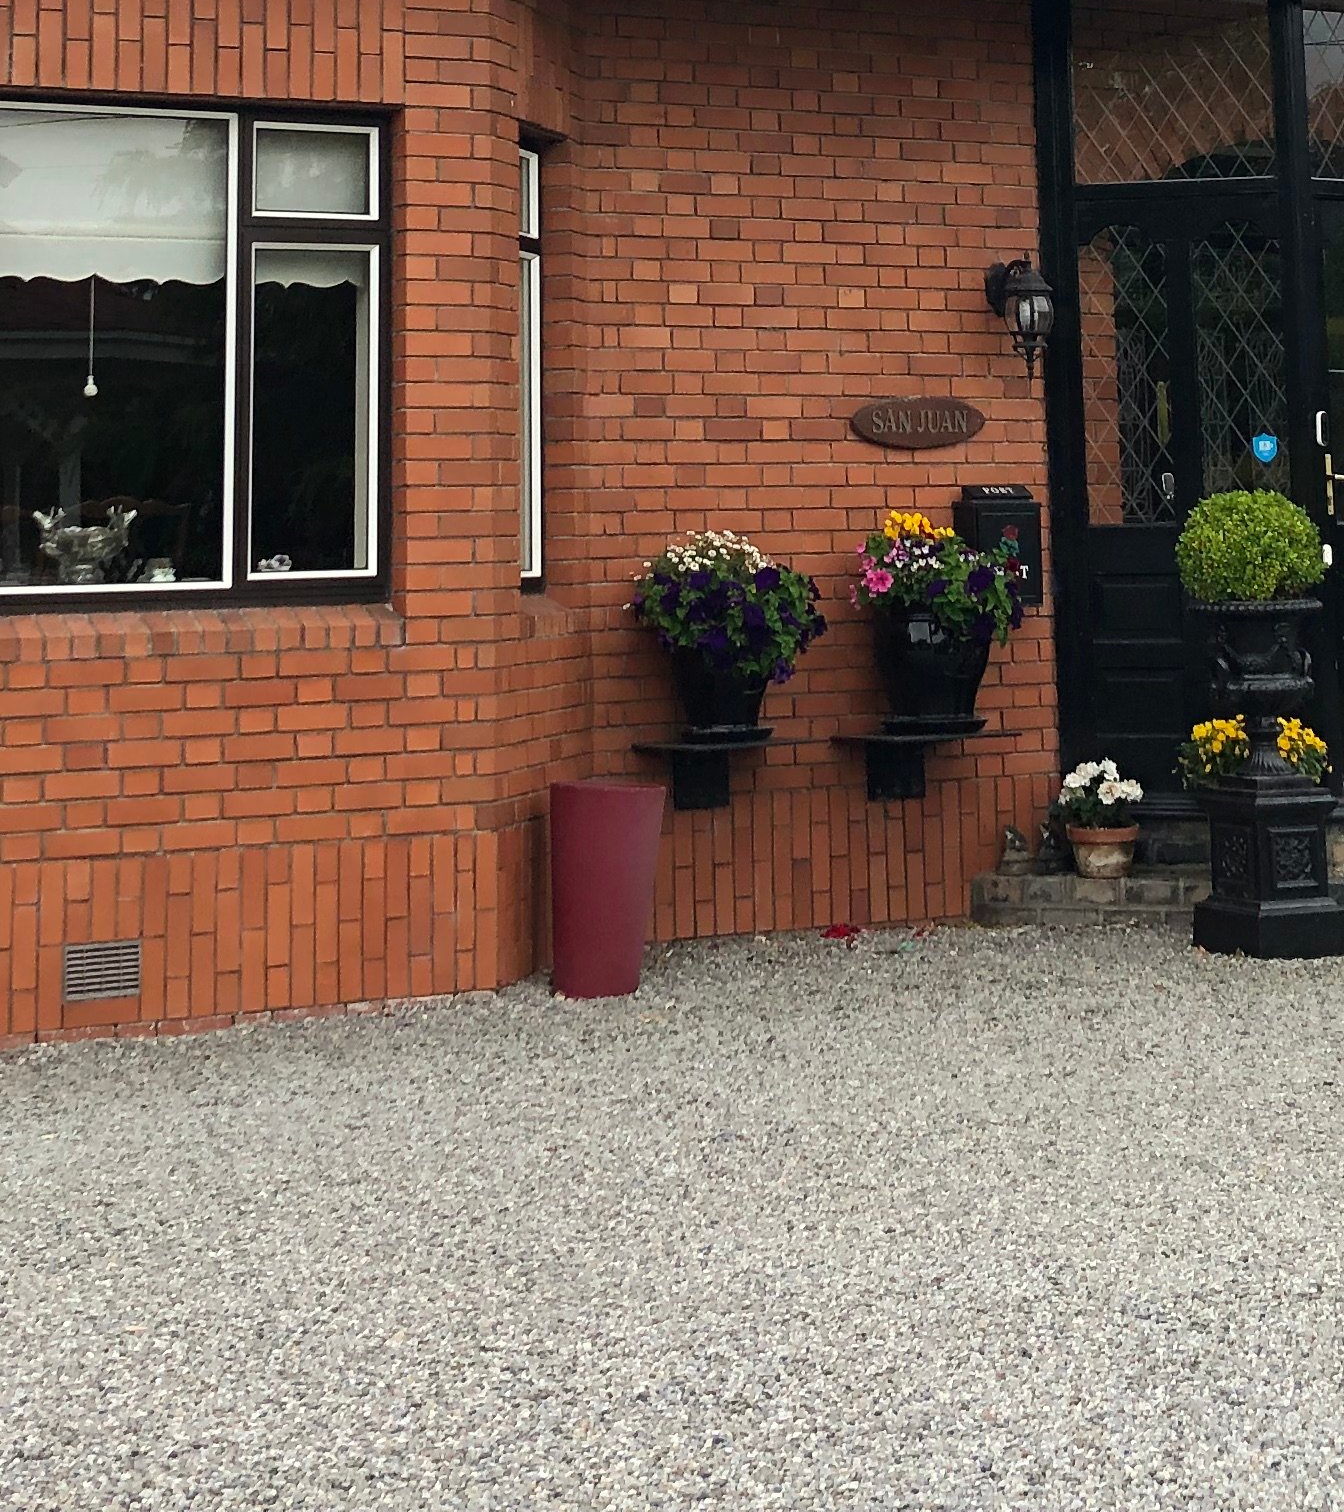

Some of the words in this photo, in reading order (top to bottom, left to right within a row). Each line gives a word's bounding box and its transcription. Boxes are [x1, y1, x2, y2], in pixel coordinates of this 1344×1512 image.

[872, 409, 912, 434] SAN
[917, 409, 968, 434] JUAN
[981, 486, 1014, 495] POST
